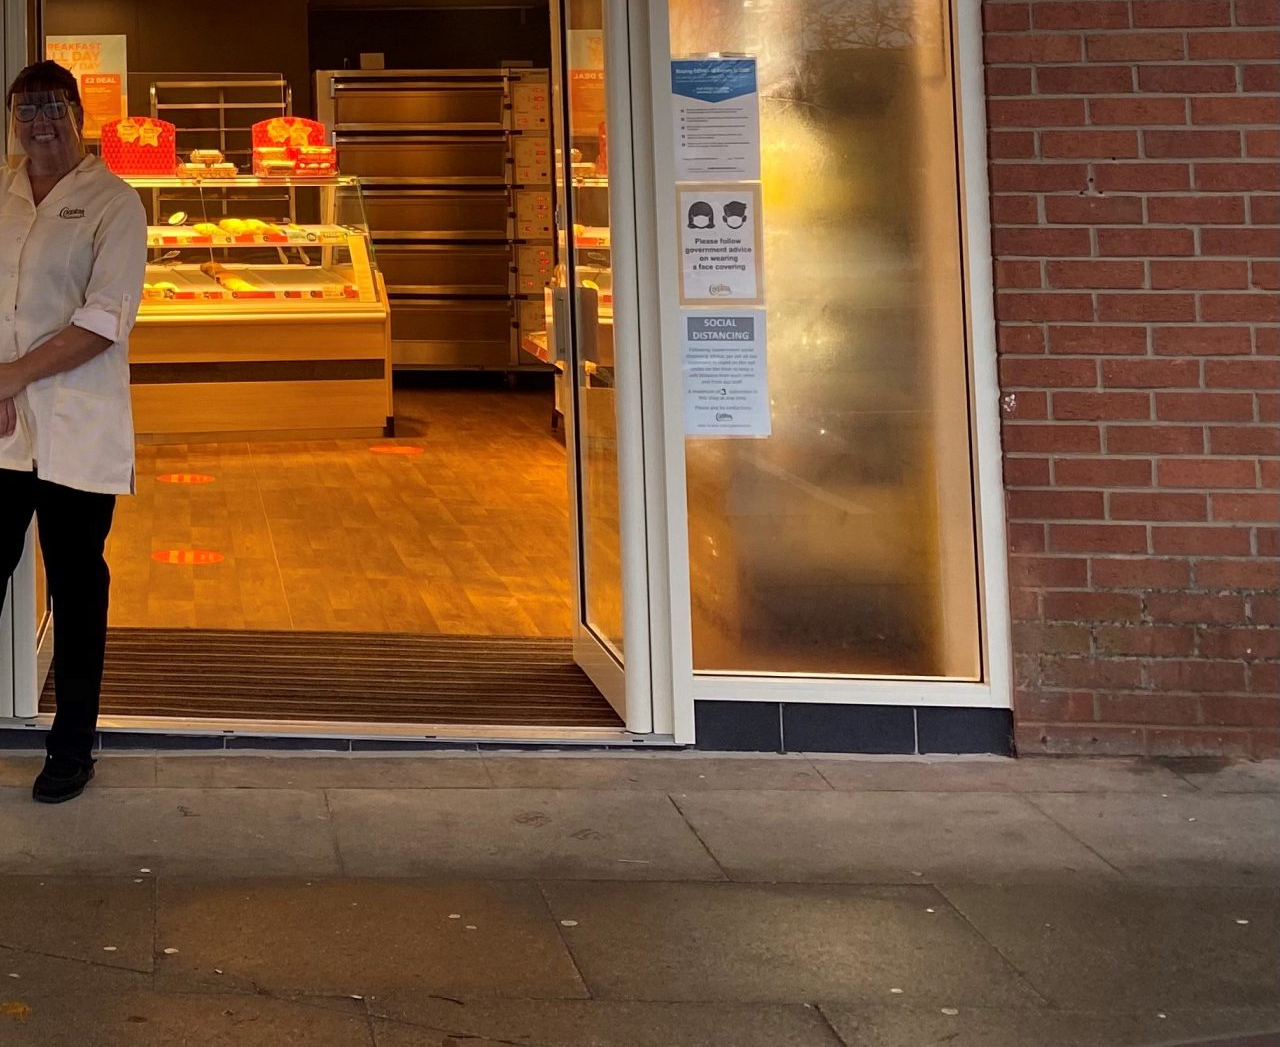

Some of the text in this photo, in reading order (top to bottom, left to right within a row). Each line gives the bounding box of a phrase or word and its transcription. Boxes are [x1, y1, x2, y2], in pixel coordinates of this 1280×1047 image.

[47, 42, 102, 51] REAKFAST
[703, 318, 737, 327] SOCIAL
[692, 331, 750, 340] DISTANCING
